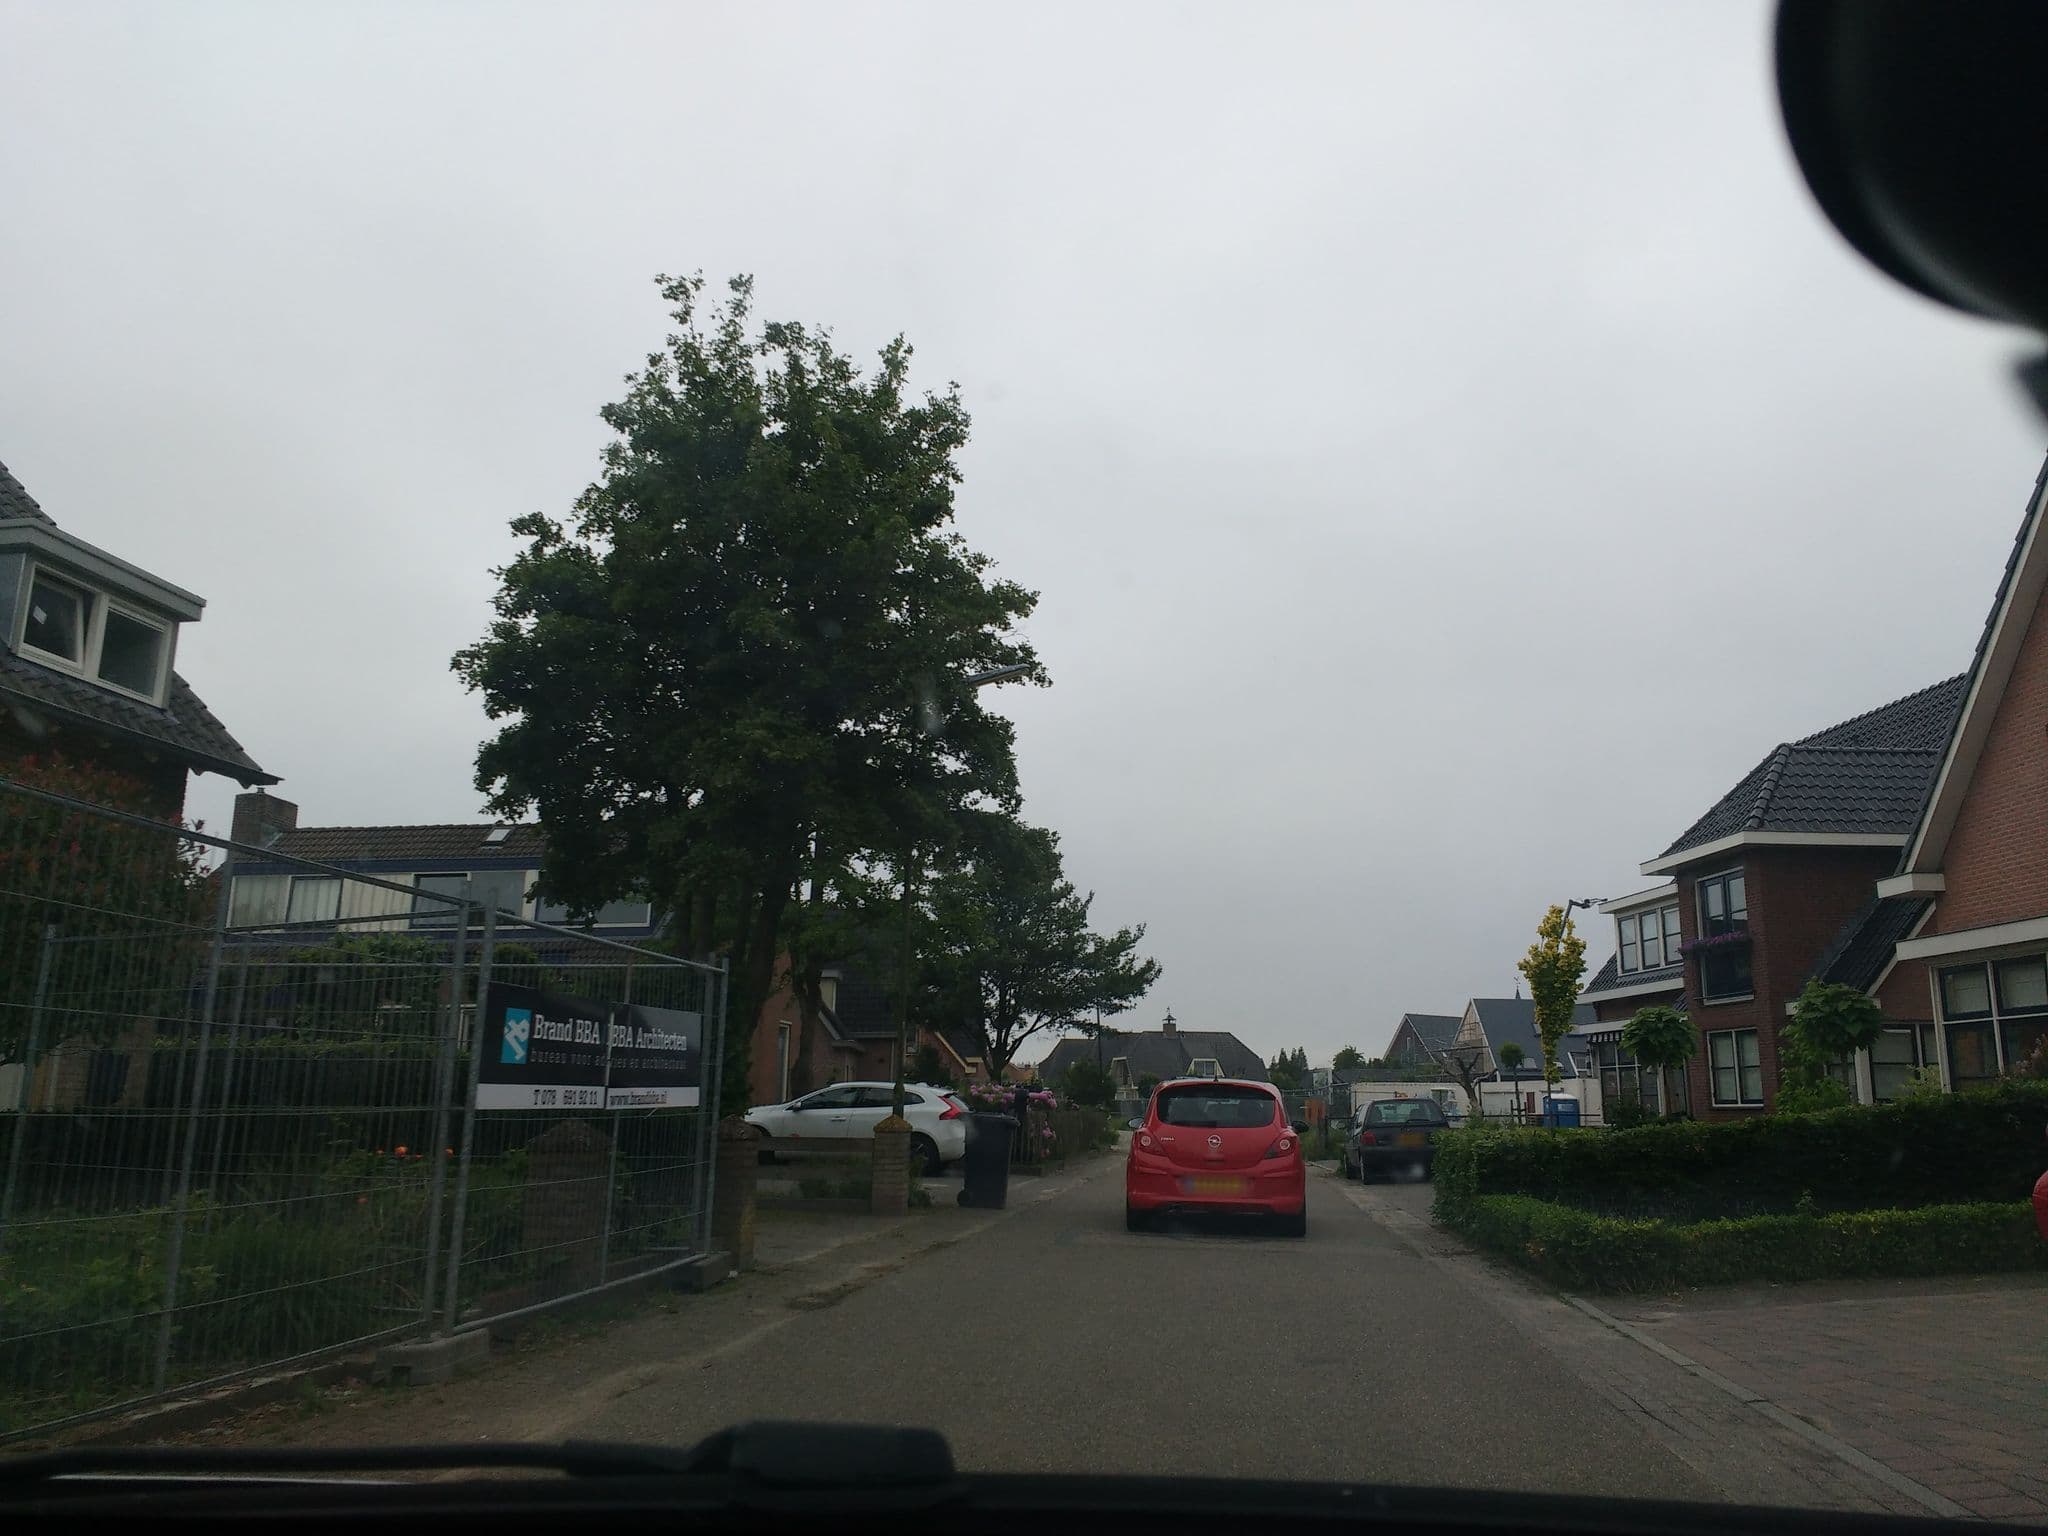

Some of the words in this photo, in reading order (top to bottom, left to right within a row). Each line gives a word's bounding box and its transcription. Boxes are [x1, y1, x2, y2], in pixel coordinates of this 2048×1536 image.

[533, 1014, 573, 1041] Brand
[574, 1019, 601, 1045] BBA
[634, 1027, 688, 1051] Architecten
[534, 1089, 540, 1105] T
